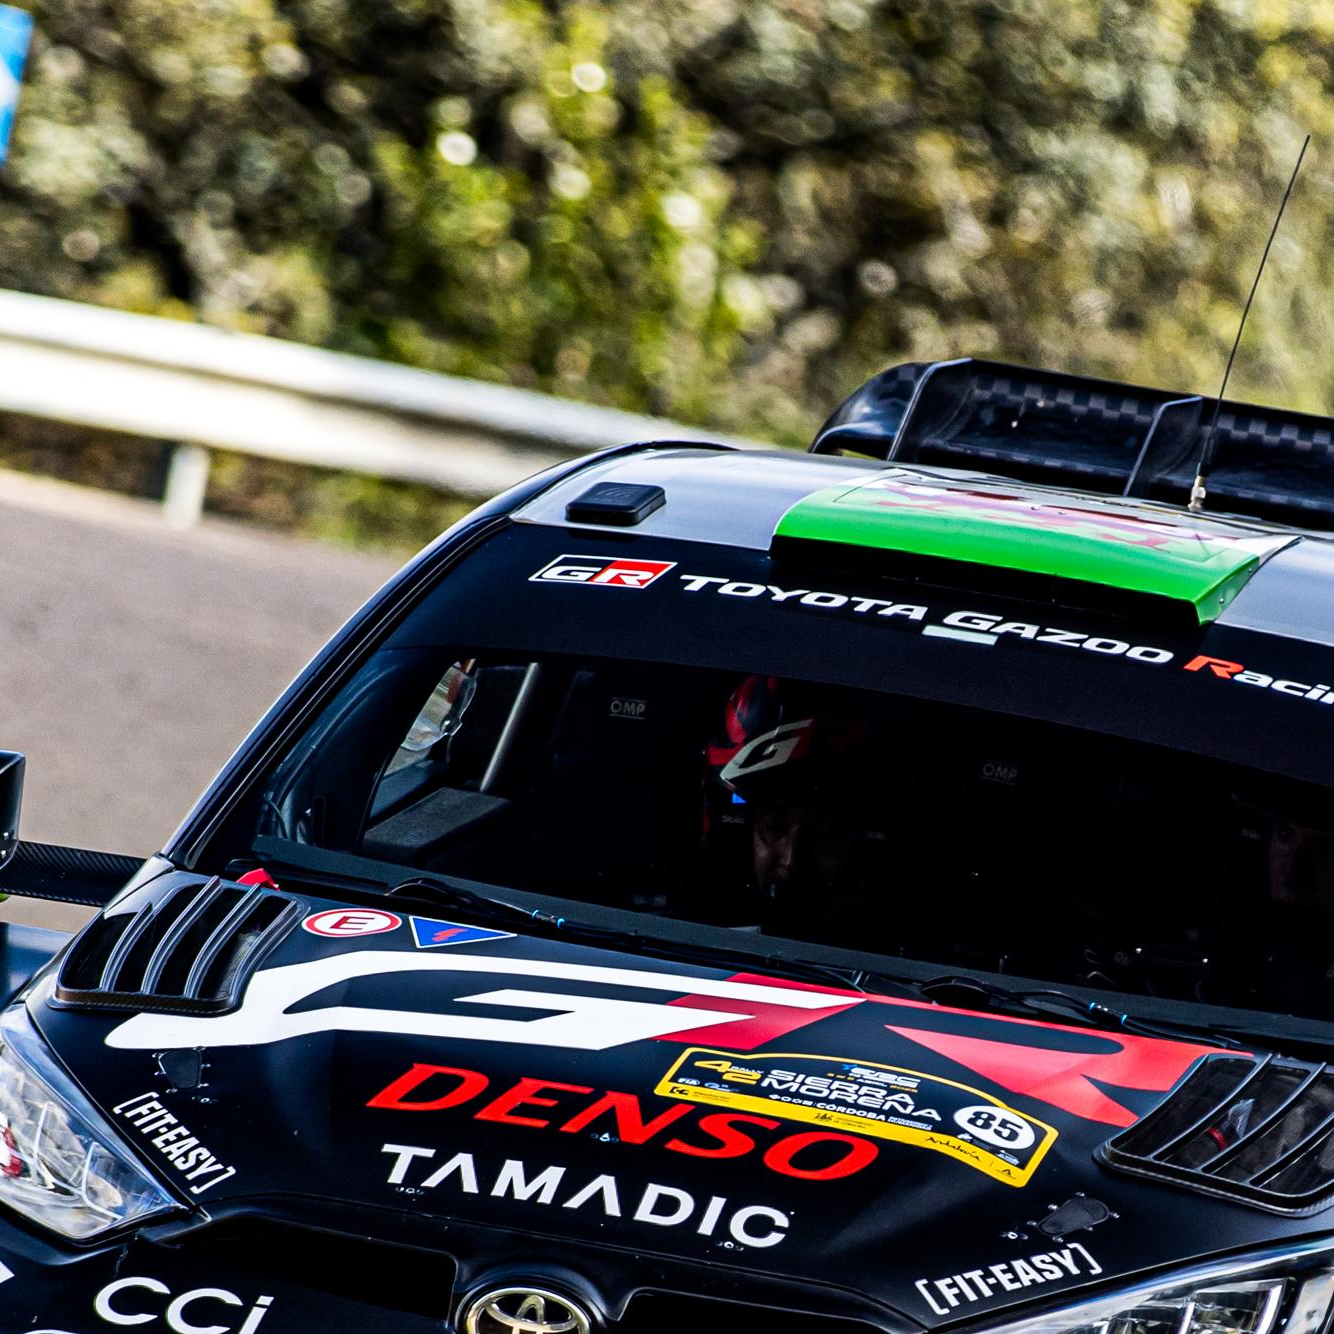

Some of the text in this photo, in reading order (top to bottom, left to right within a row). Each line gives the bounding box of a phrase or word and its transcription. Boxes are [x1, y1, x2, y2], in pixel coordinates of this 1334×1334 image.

[681, 574, 927, 621] TOYOTA
[941, 610, 1175, 664] GAZOO
[760, 1077, 943, 1122] MORENA
[768, 1069, 915, 1105] SIERRA
[366, 1063, 879, 1181] DENSO
[967, 1111, 1023, 1142] 85
[381, 1143, 791, 1250] TAMADIC
